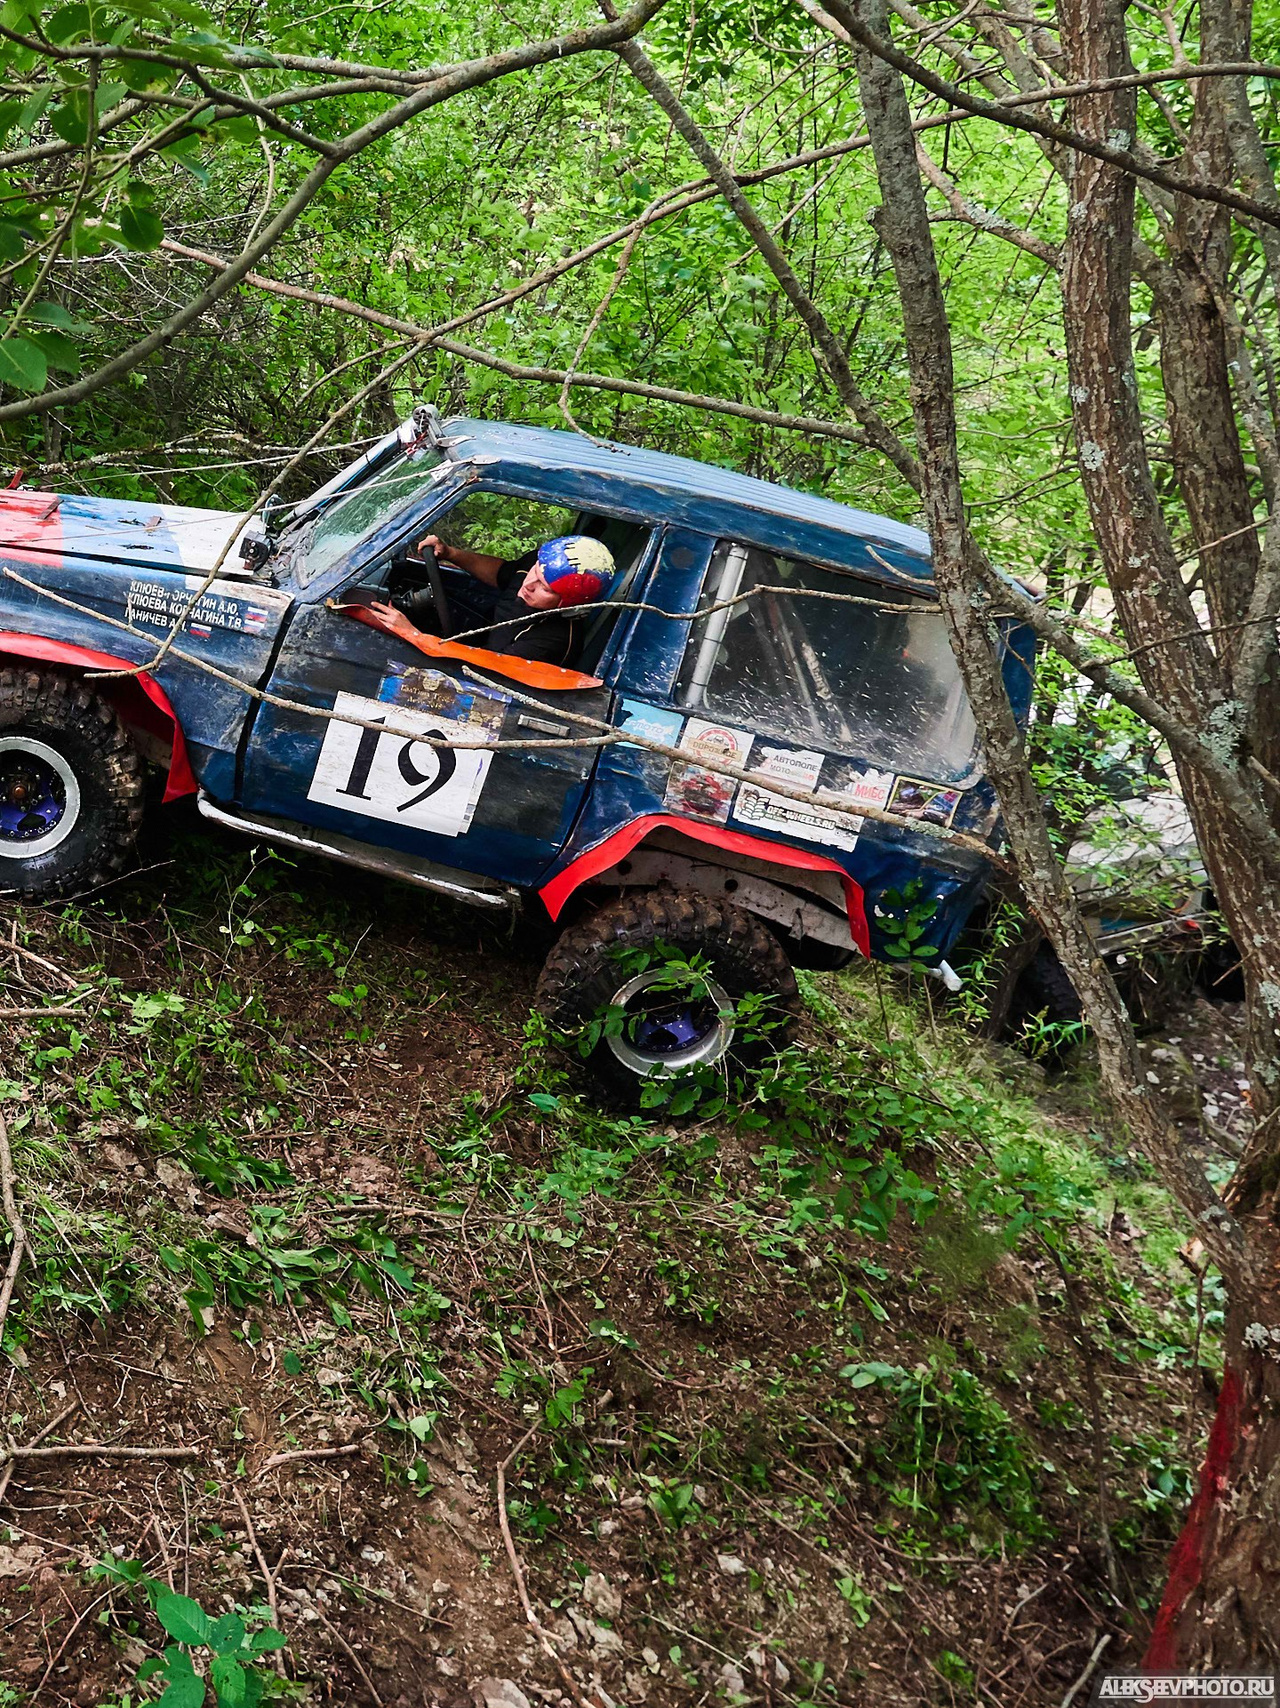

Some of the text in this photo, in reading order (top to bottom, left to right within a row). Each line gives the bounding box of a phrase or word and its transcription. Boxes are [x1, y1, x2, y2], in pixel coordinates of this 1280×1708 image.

[218, 600, 239, 616] А.Ю.
[228, 616, 244, 630] Т.В.
[336, 716, 457, 813] 19
[774, 755, 818, 772] АВТОПОЛЕ
[855, 783, 886, 801] МИБС
[765, 804, 836, 831] OFF-WHEELS.RU
